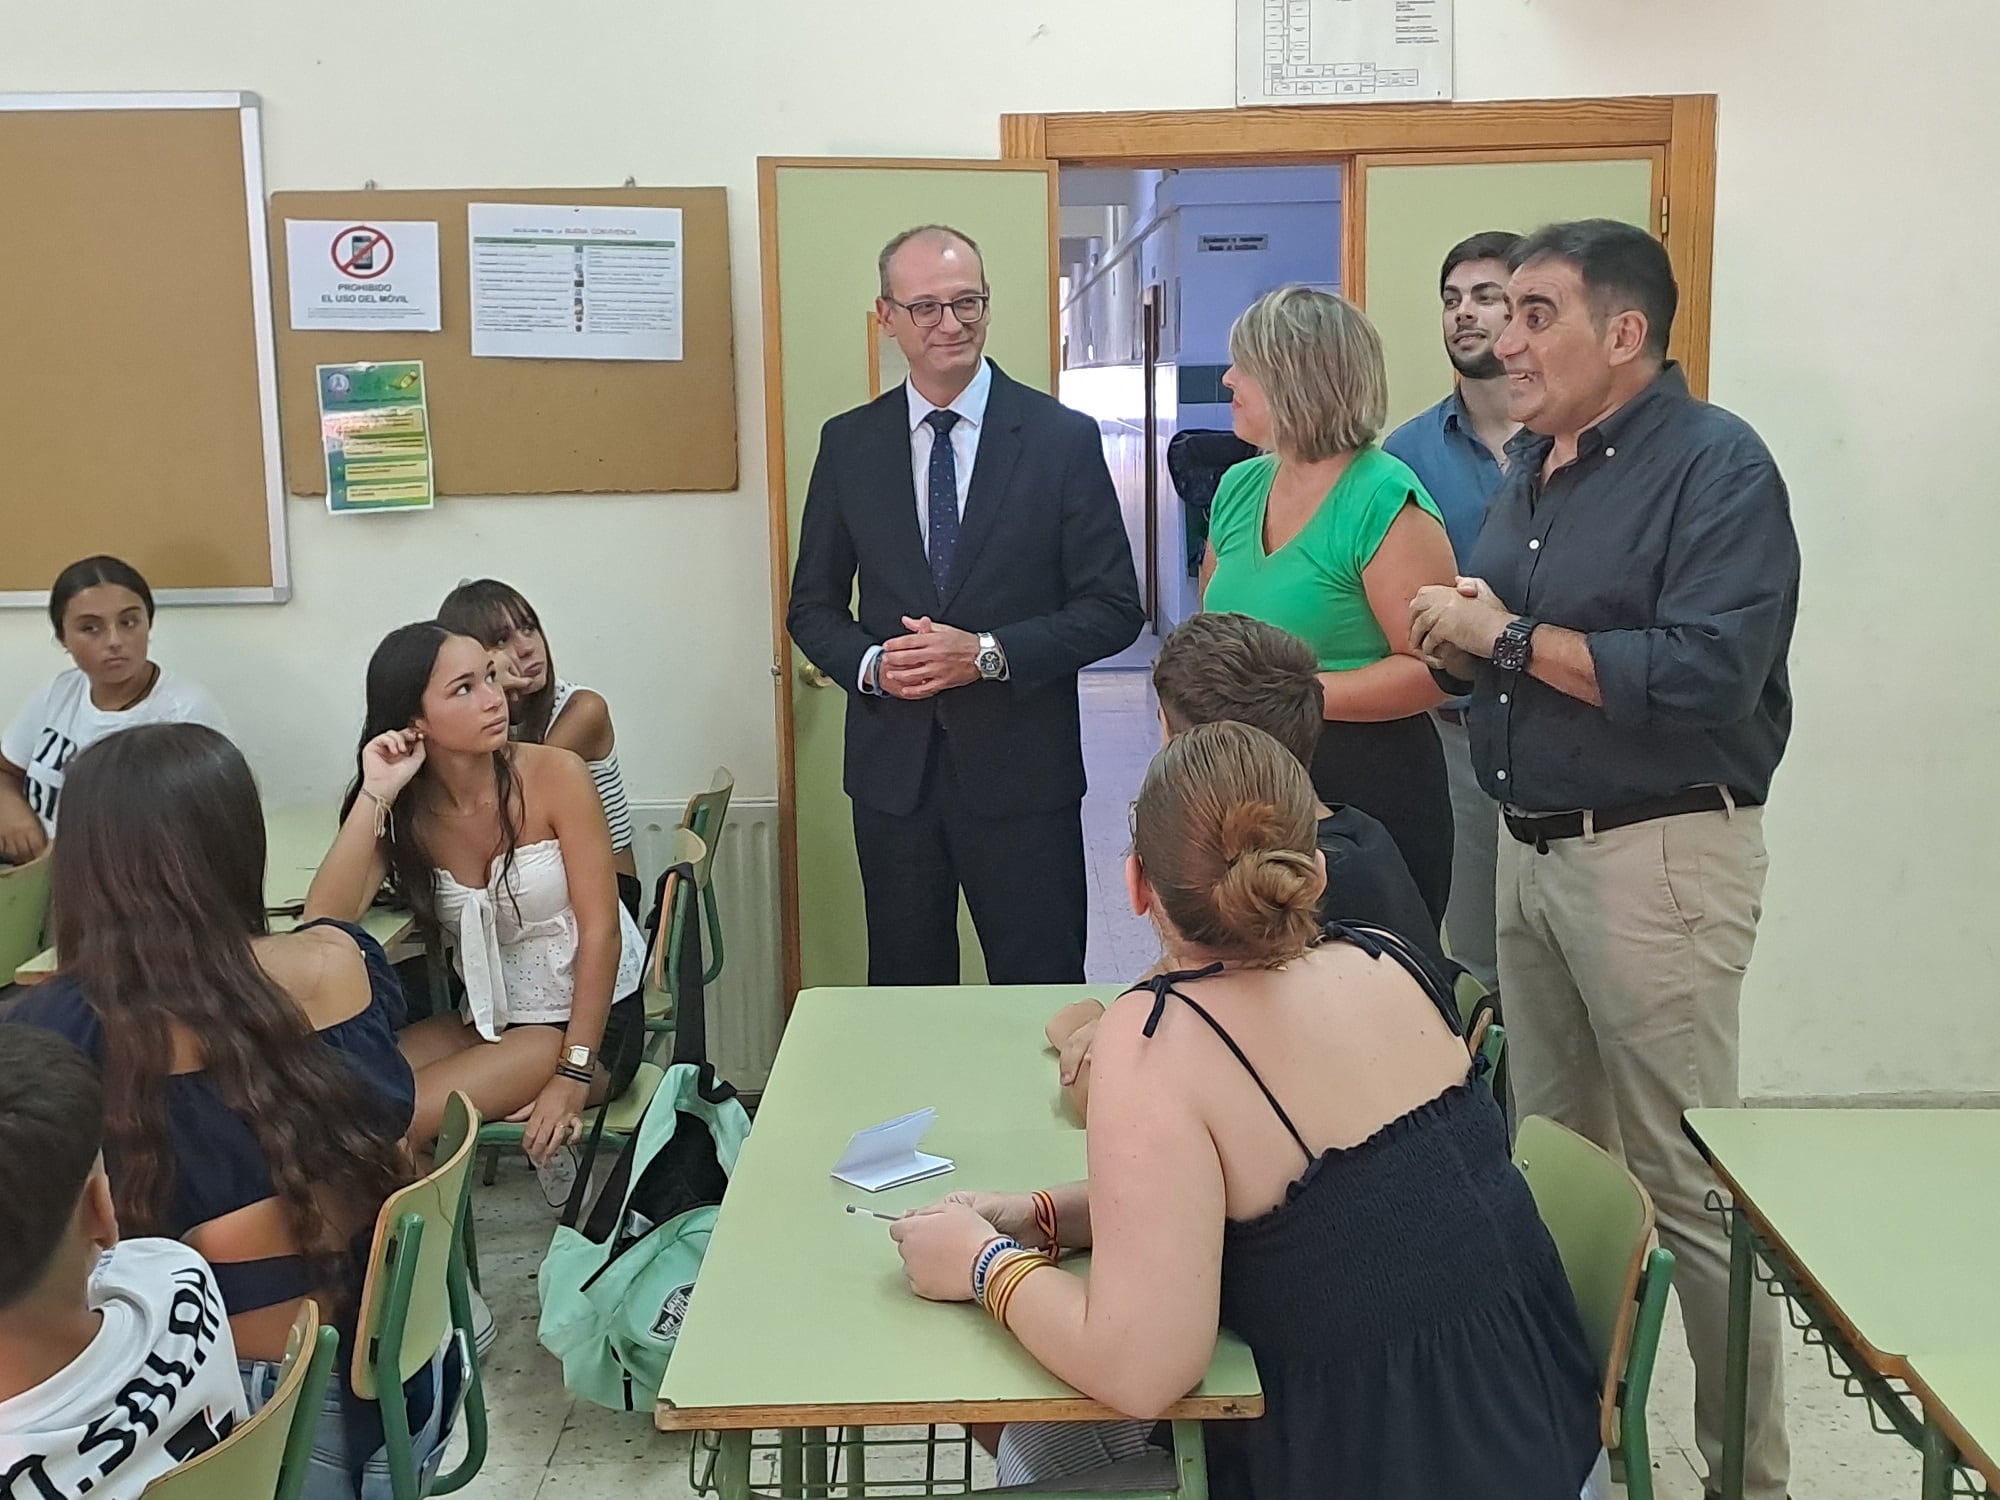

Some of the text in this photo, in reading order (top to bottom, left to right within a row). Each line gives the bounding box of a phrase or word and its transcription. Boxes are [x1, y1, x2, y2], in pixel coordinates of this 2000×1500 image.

[337, 283, 392, 292] PROHIBIDO
[321, 293, 409, 304] EL USO DEL MÓVIL
